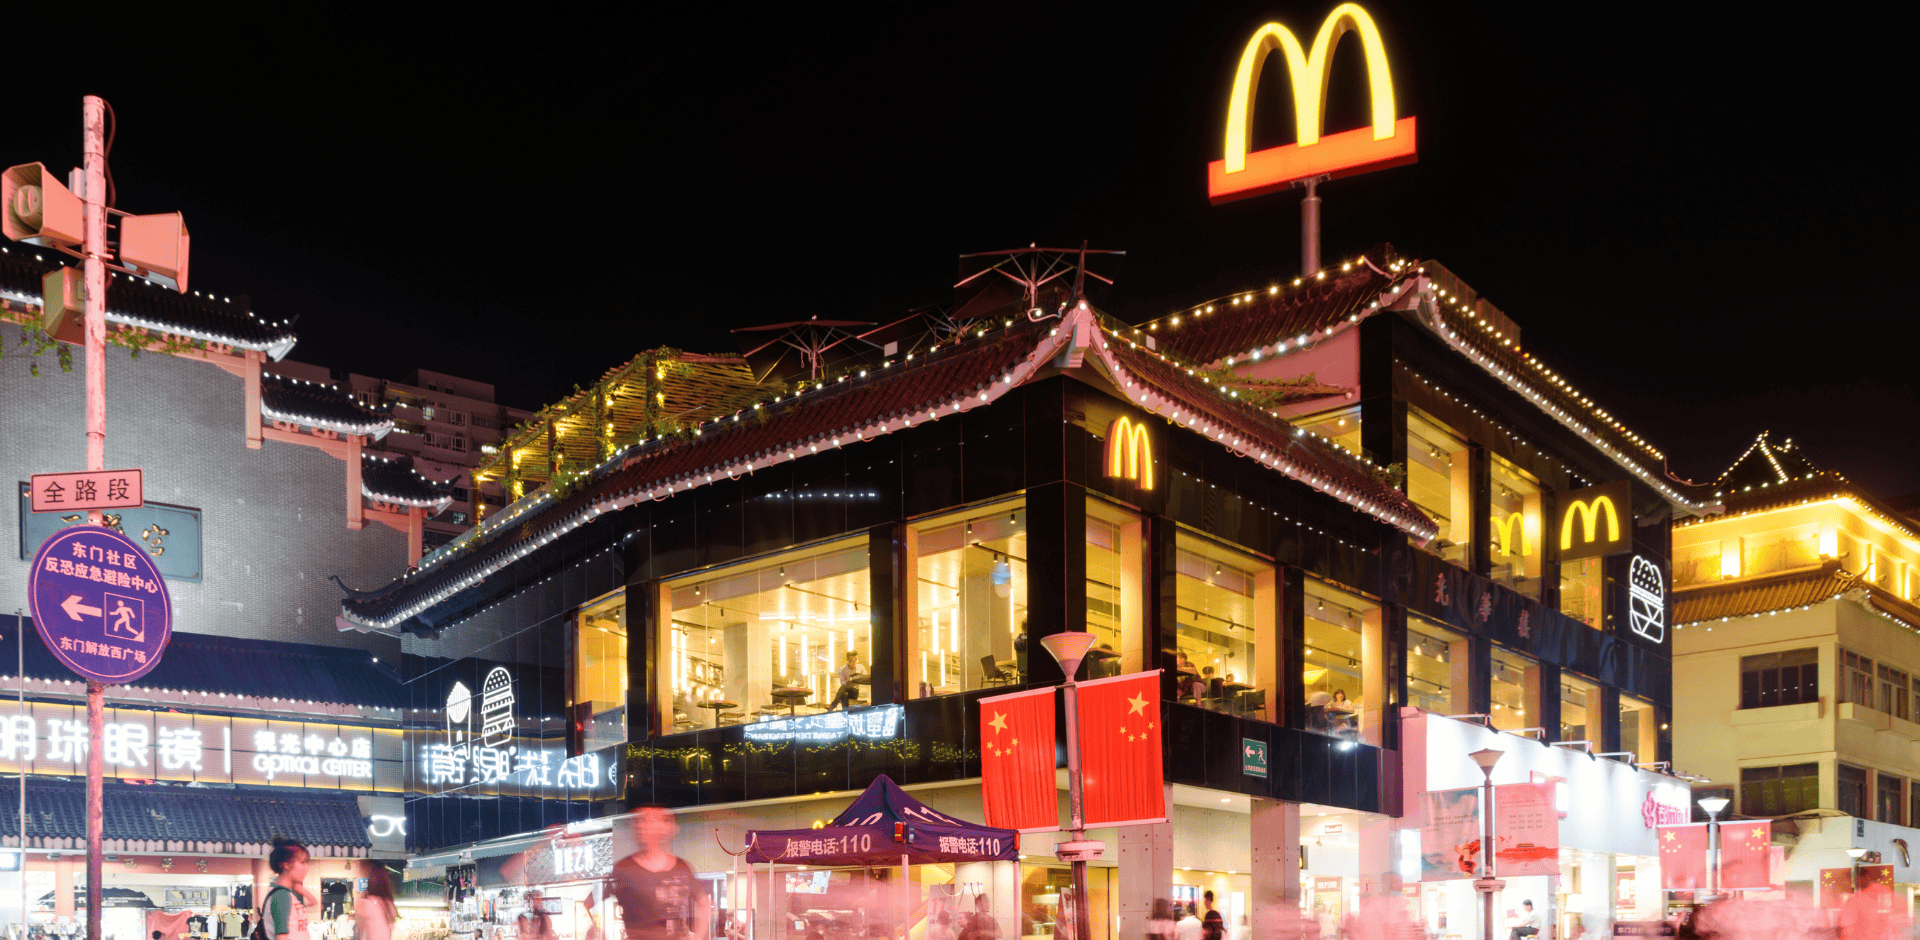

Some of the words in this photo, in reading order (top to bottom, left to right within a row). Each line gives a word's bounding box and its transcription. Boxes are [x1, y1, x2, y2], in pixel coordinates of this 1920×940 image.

[43, 478, 129, 503] 全路段
[72, 542, 137, 570] 东门社区
[45, 557, 158, 593] 反恐应急避险中心
[60, 637, 146, 664] 东门解放西广场
[0, 715, 203, 771] 明珠眼镜
[787, 833, 871, 858] 报警电话:110
[939, 836, 1000, 857] 报警电话:110
